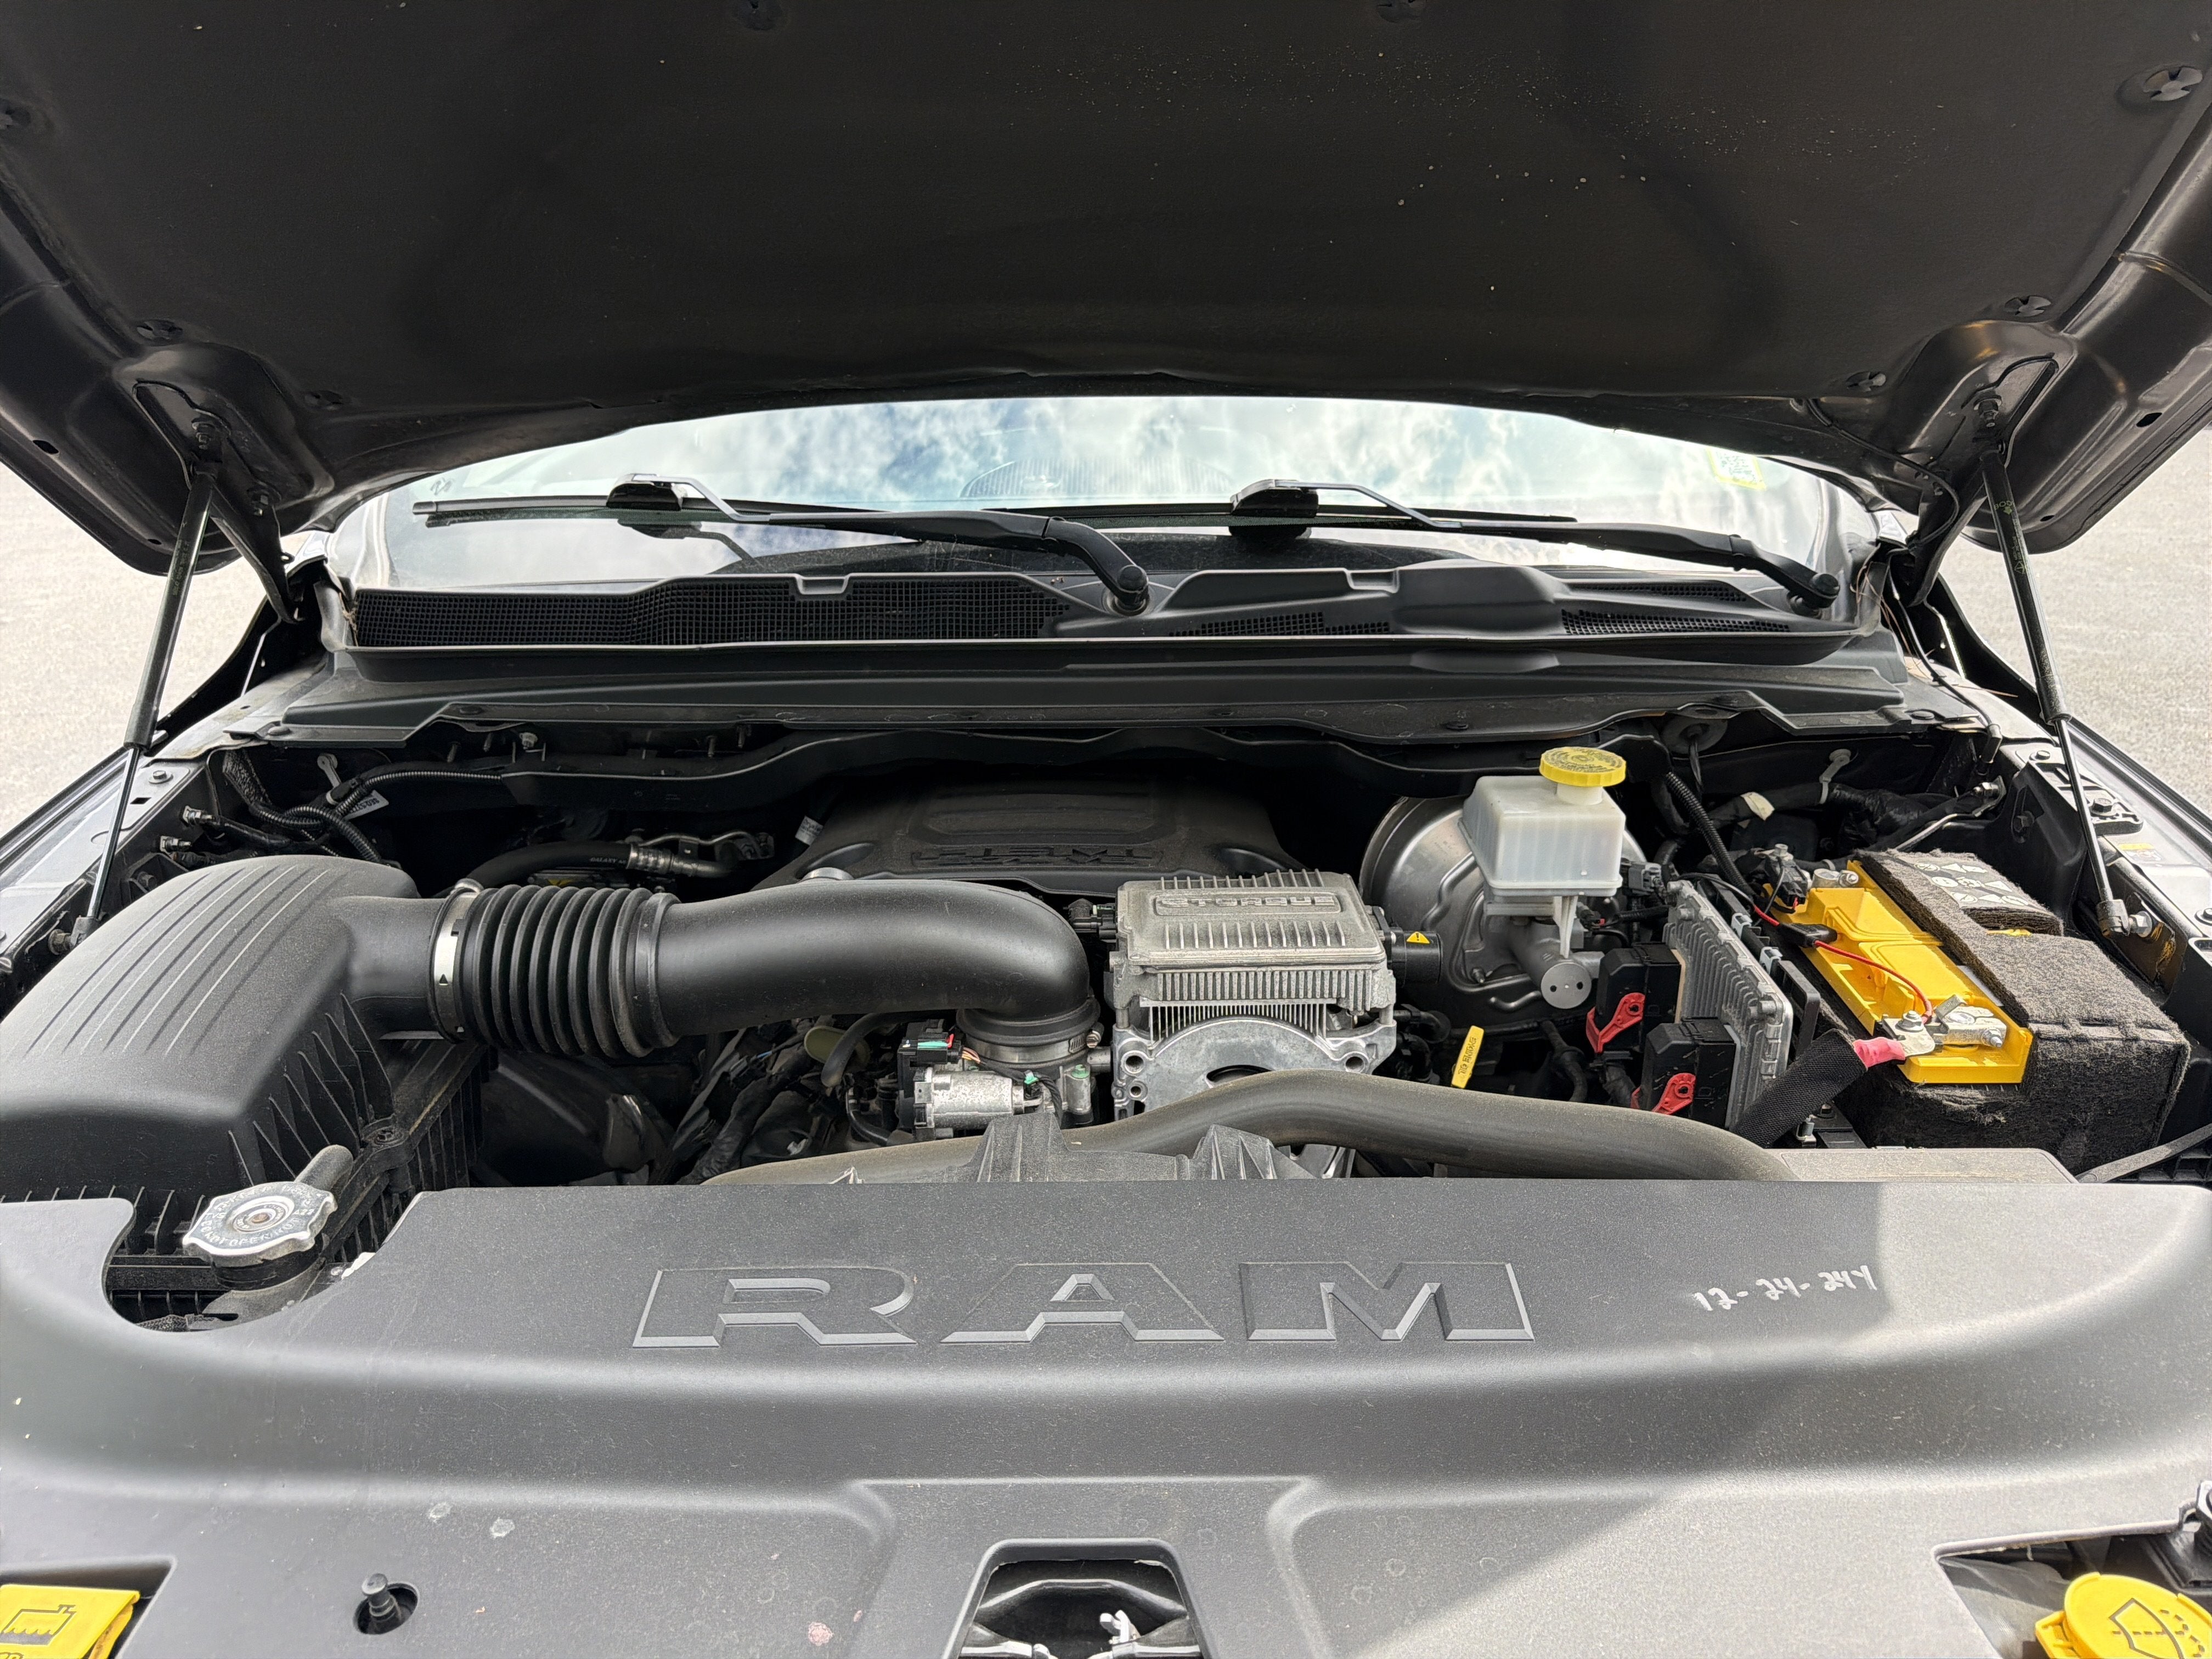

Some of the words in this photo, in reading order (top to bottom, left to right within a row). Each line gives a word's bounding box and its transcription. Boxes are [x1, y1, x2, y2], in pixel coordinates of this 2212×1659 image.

[1462, 1036, 1477, 1063] ENGINE
[1458, 1063, 1469, 1075] OIL
[229, 1233, 273, 1246] OPEN
[632, 1261, 1534, 1348] RAM
